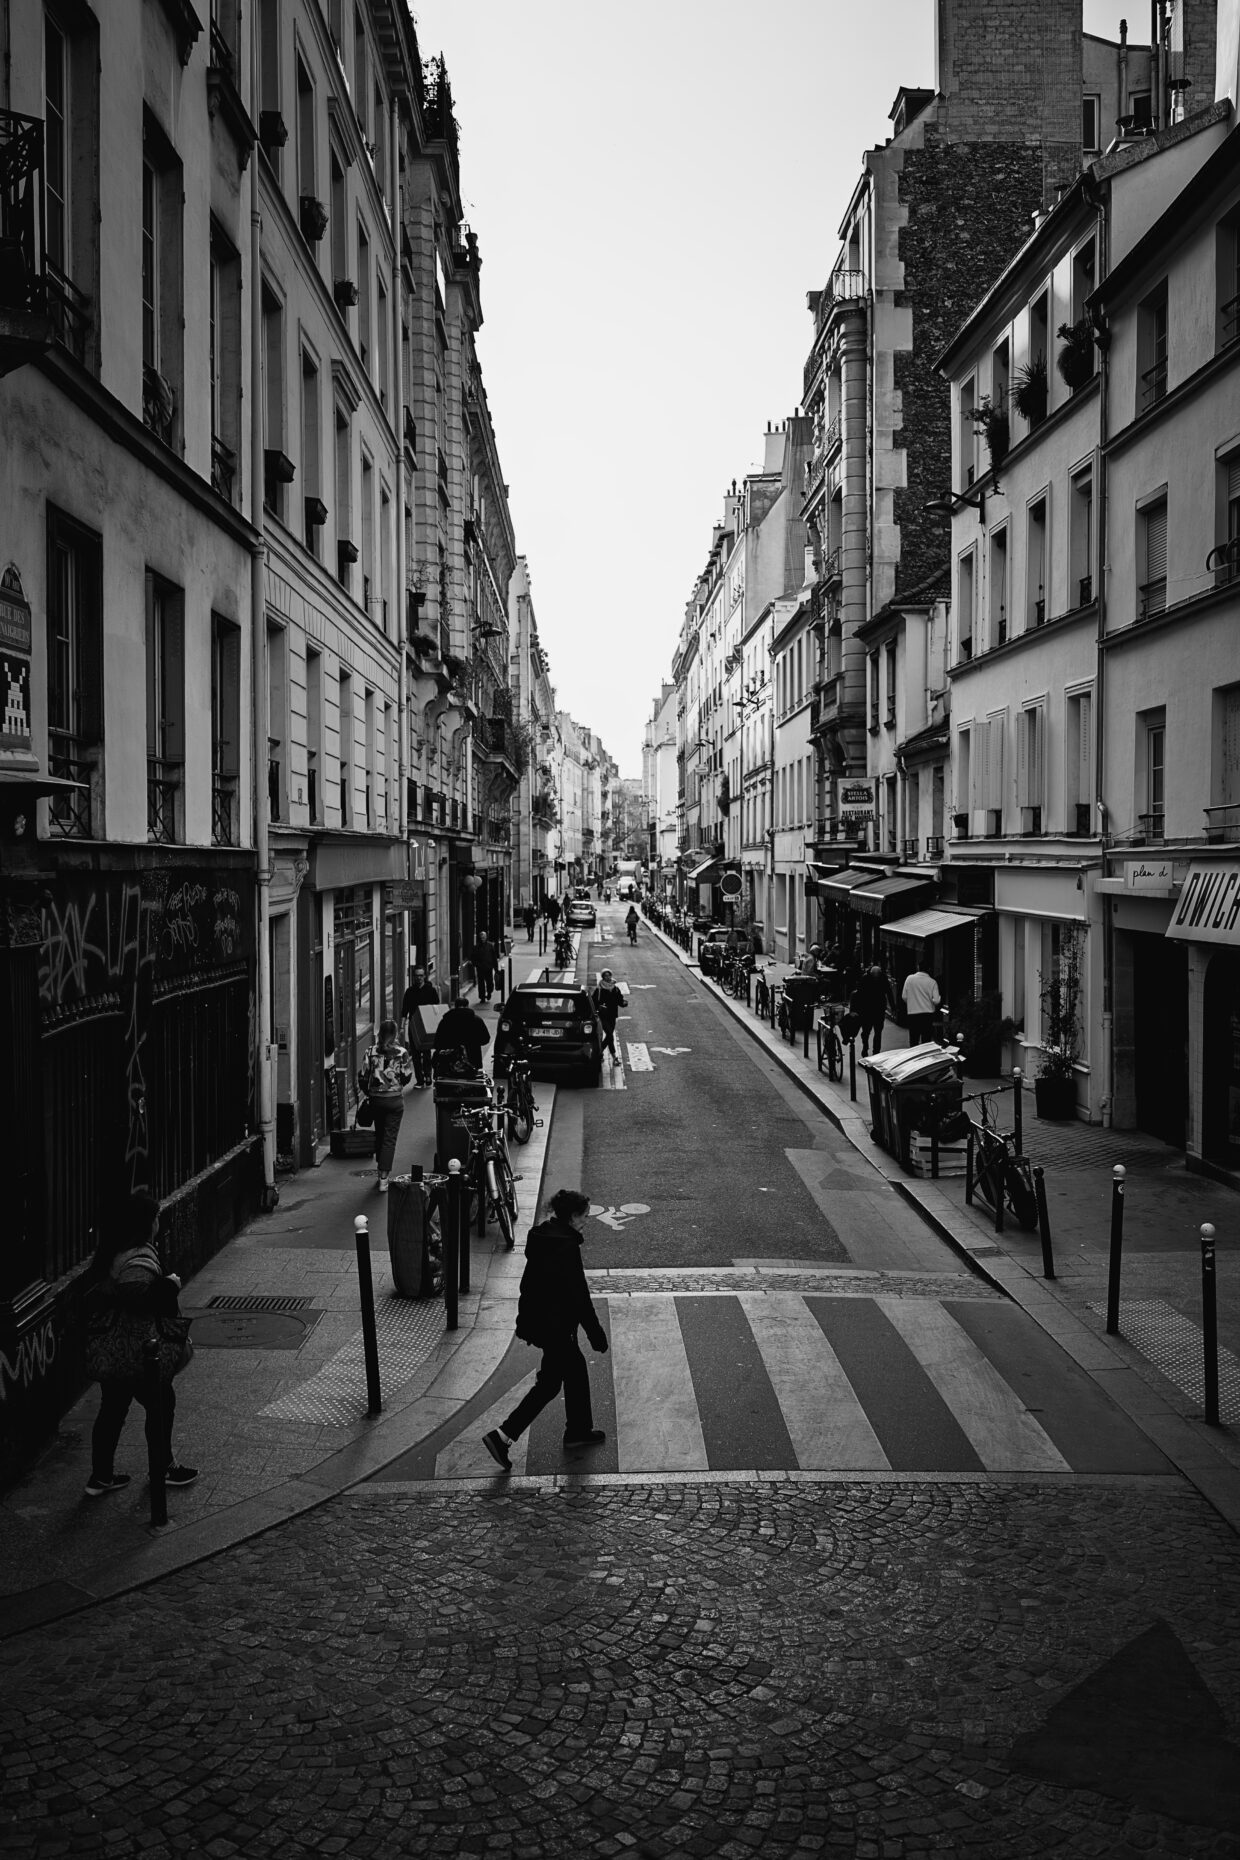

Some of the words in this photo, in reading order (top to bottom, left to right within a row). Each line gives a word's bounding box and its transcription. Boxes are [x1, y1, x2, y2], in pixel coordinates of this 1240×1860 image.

[13, 608, 25, 625] DES
[1133, 864, 1156, 887] plan
[1158, 866, 1169, 878] d
